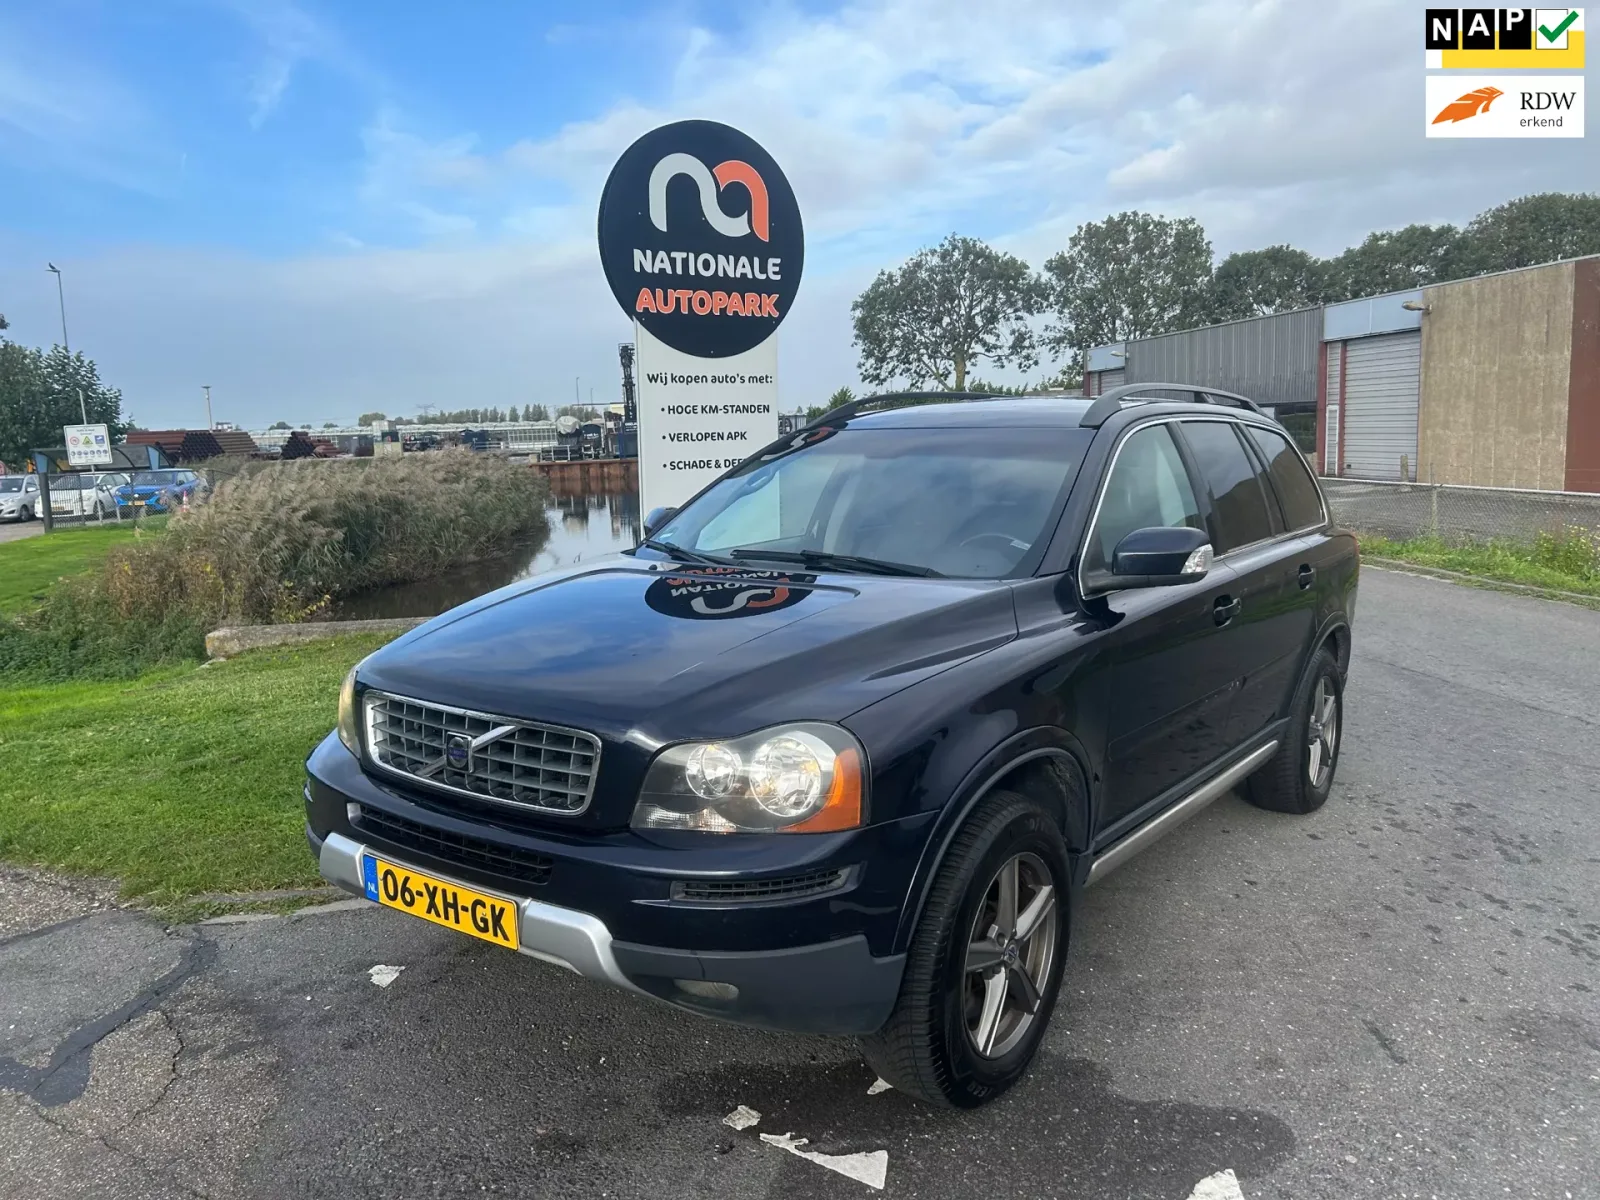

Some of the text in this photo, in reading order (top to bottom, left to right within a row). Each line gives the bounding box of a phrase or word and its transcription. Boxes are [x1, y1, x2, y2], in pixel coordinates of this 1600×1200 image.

[633, 248, 781, 280] NATIONALE
[635, 287, 779, 317] AUTOPARK
[647, 372, 773, 385] Wij kopen auto's met:
[667, 404, 770, 414] HOGE KM-STANDEN
[668, 431, 747, 442] VERLOPEN APK
[669, 460, 712, 470] SCHADE
[714, 459, 722, 469] &
[367, 881, 378, 894] NL
[381, 868, 511, 942] 06-XH-GK
